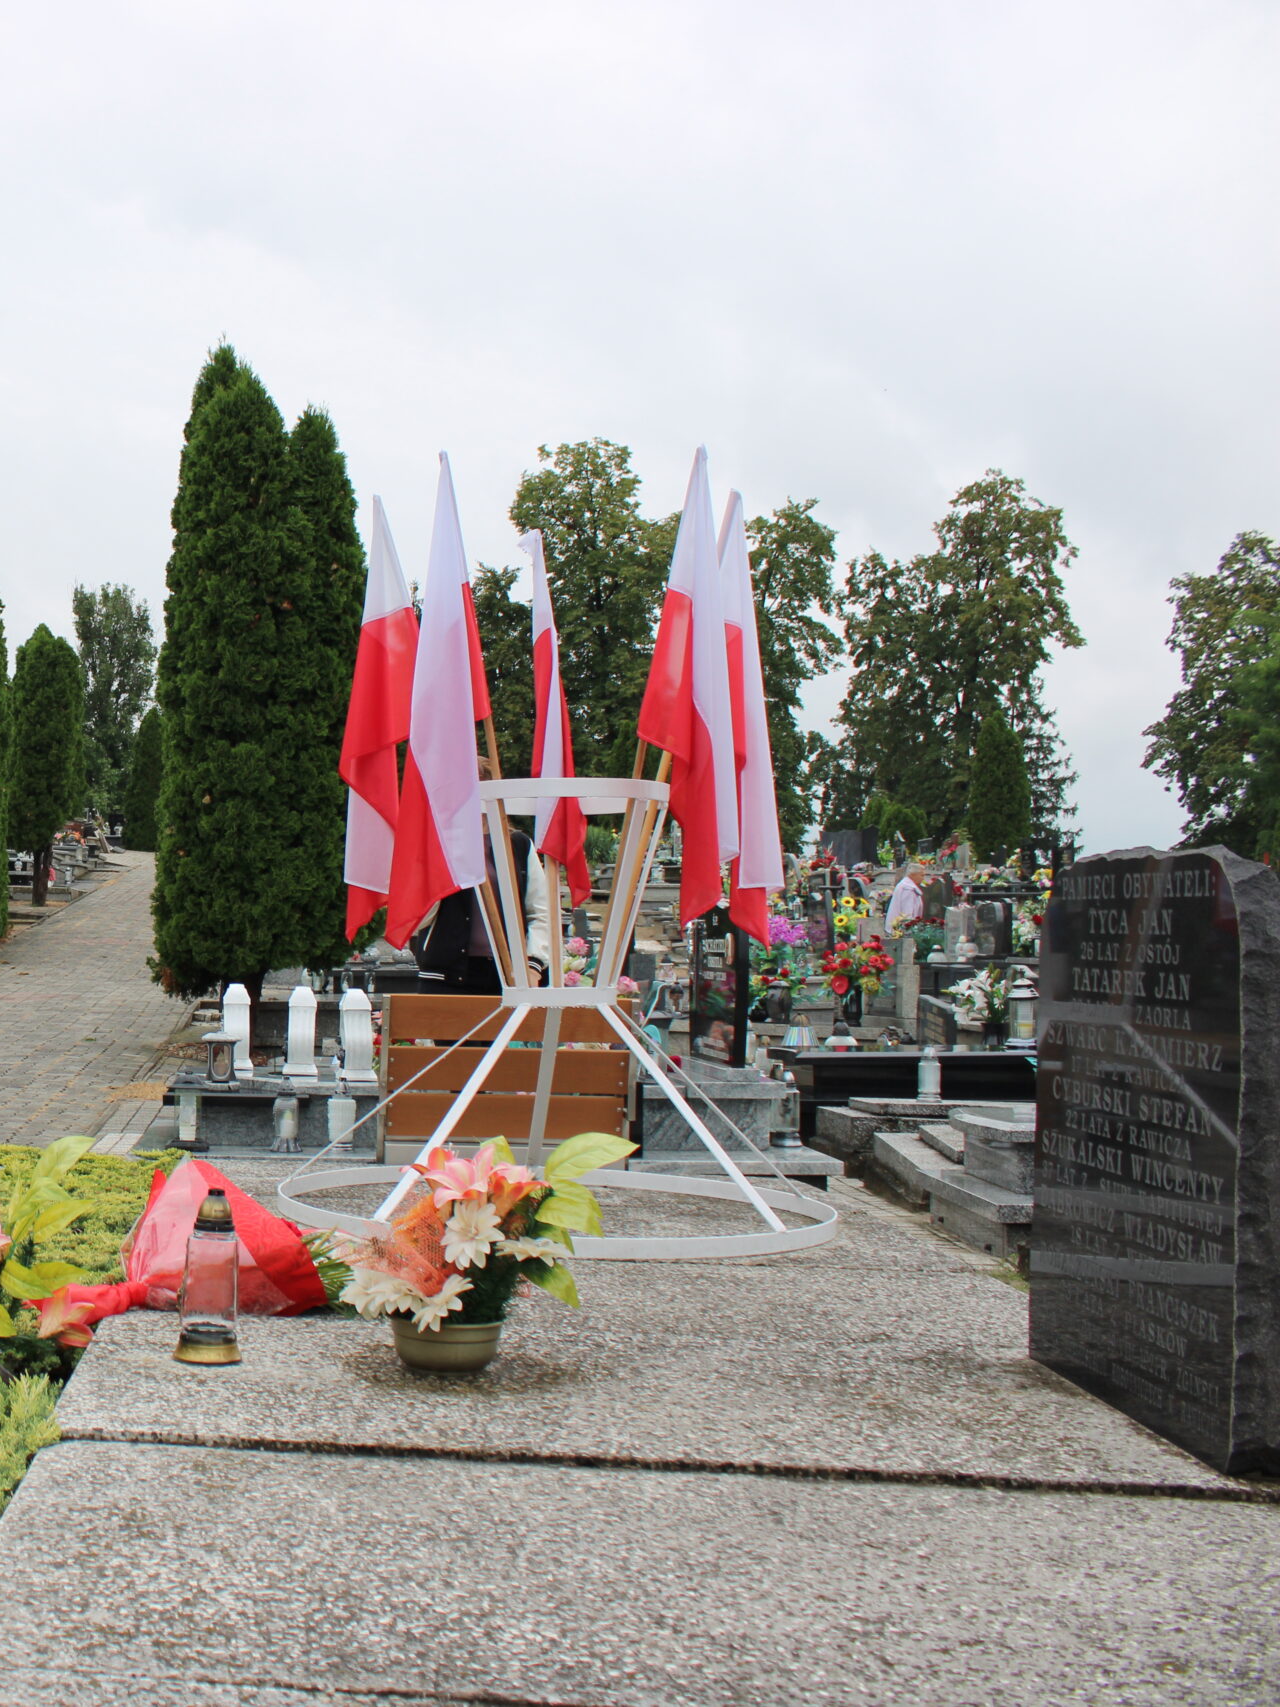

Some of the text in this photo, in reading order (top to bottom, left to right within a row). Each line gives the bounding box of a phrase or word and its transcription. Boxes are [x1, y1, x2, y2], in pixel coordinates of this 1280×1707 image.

[1088, 909, 1173, 936] TYCA JAN
[1080, 941, 1094, 961] 26
[1097, 942, 1120, 962] LAT
[1072, 967, 1191, 1001] TATAREK JAN
[1135, 1004, 1192, 1031] ZAORLA
[1047, 1022, 1224, 1072] SZWARC KAZIMIERZ
[1052, 1076, 1212, 1137] CYBURSKI STEFAN
[1065, 1109, 1193, 1162] 22 LATA Z RAWICZA
[1131, 1153, 1224, 1205] WINCENTY
[1128, 1279, 1219, 1344] FRANCISZEK
